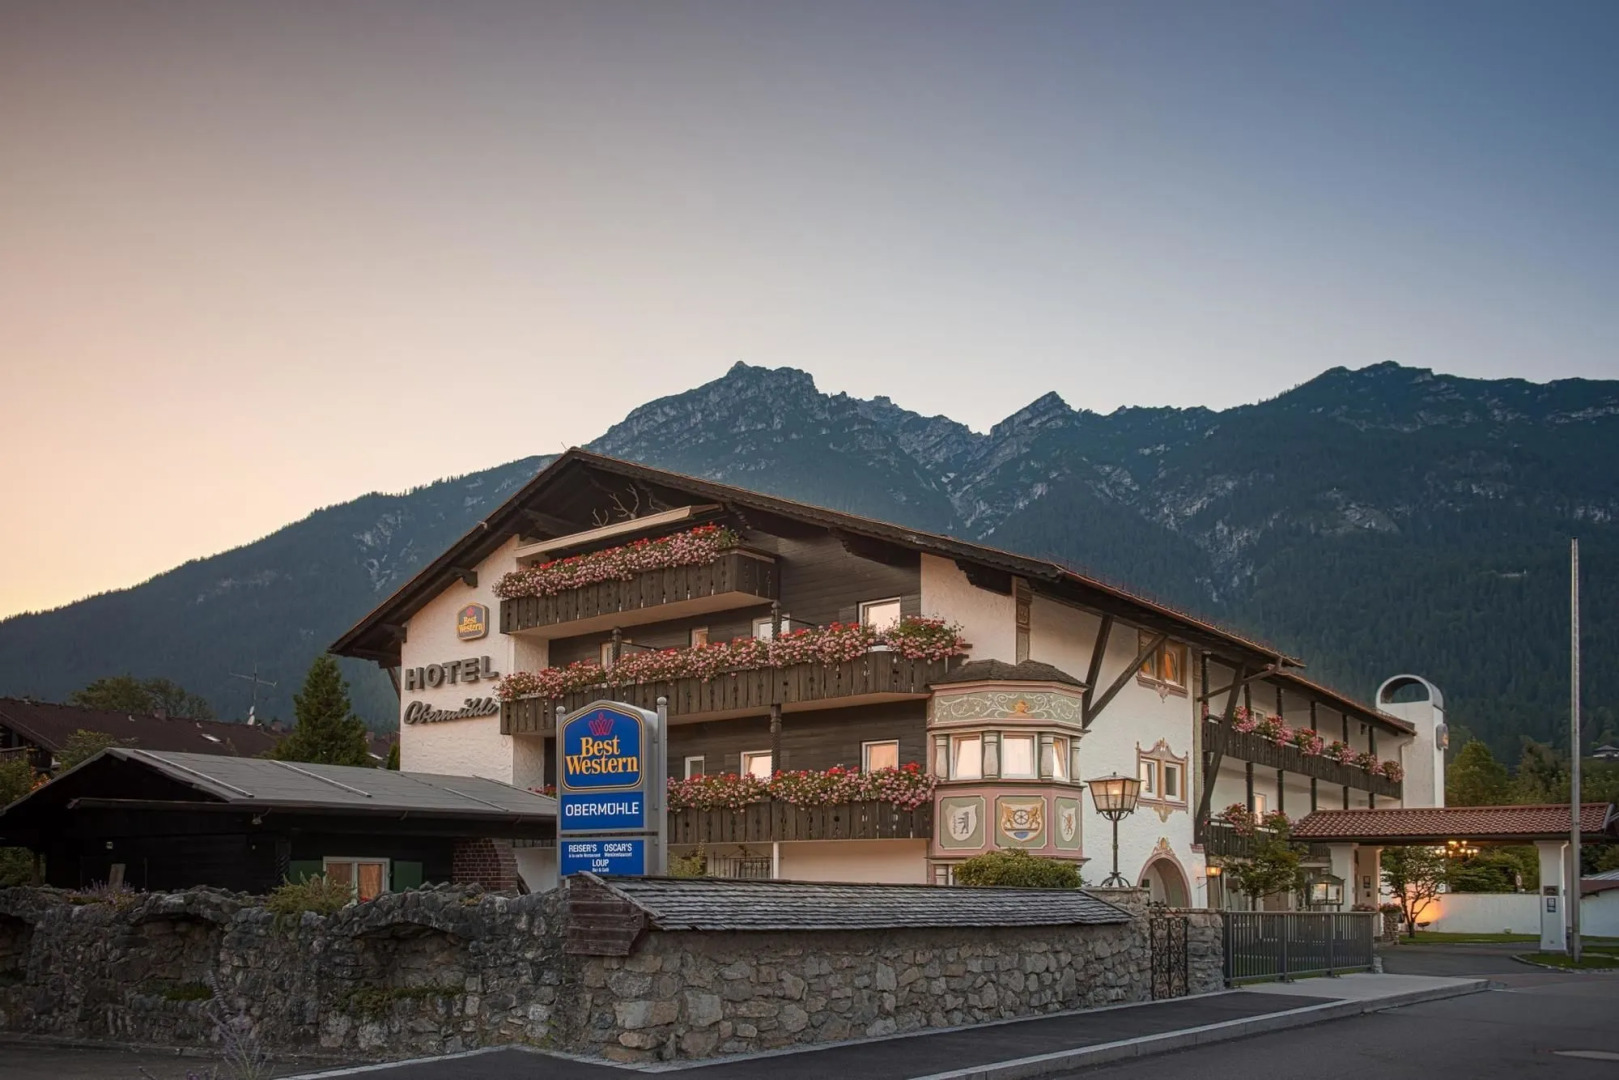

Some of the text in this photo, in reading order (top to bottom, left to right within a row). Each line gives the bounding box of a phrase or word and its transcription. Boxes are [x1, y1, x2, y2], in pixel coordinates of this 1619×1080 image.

[463, 616, 477, 625] Best
[459, 623, 483, 633] Western
[404, 655, 500, 691] HOTEL
[580, 734, 620, 757] Best
[565, 754, 639, 775] Western
[566, 802, 640, 816] OBERMÜHLE
[604, 844, 632, 852] OSCAR'S
[592, 859, 609, 867] LOUP
